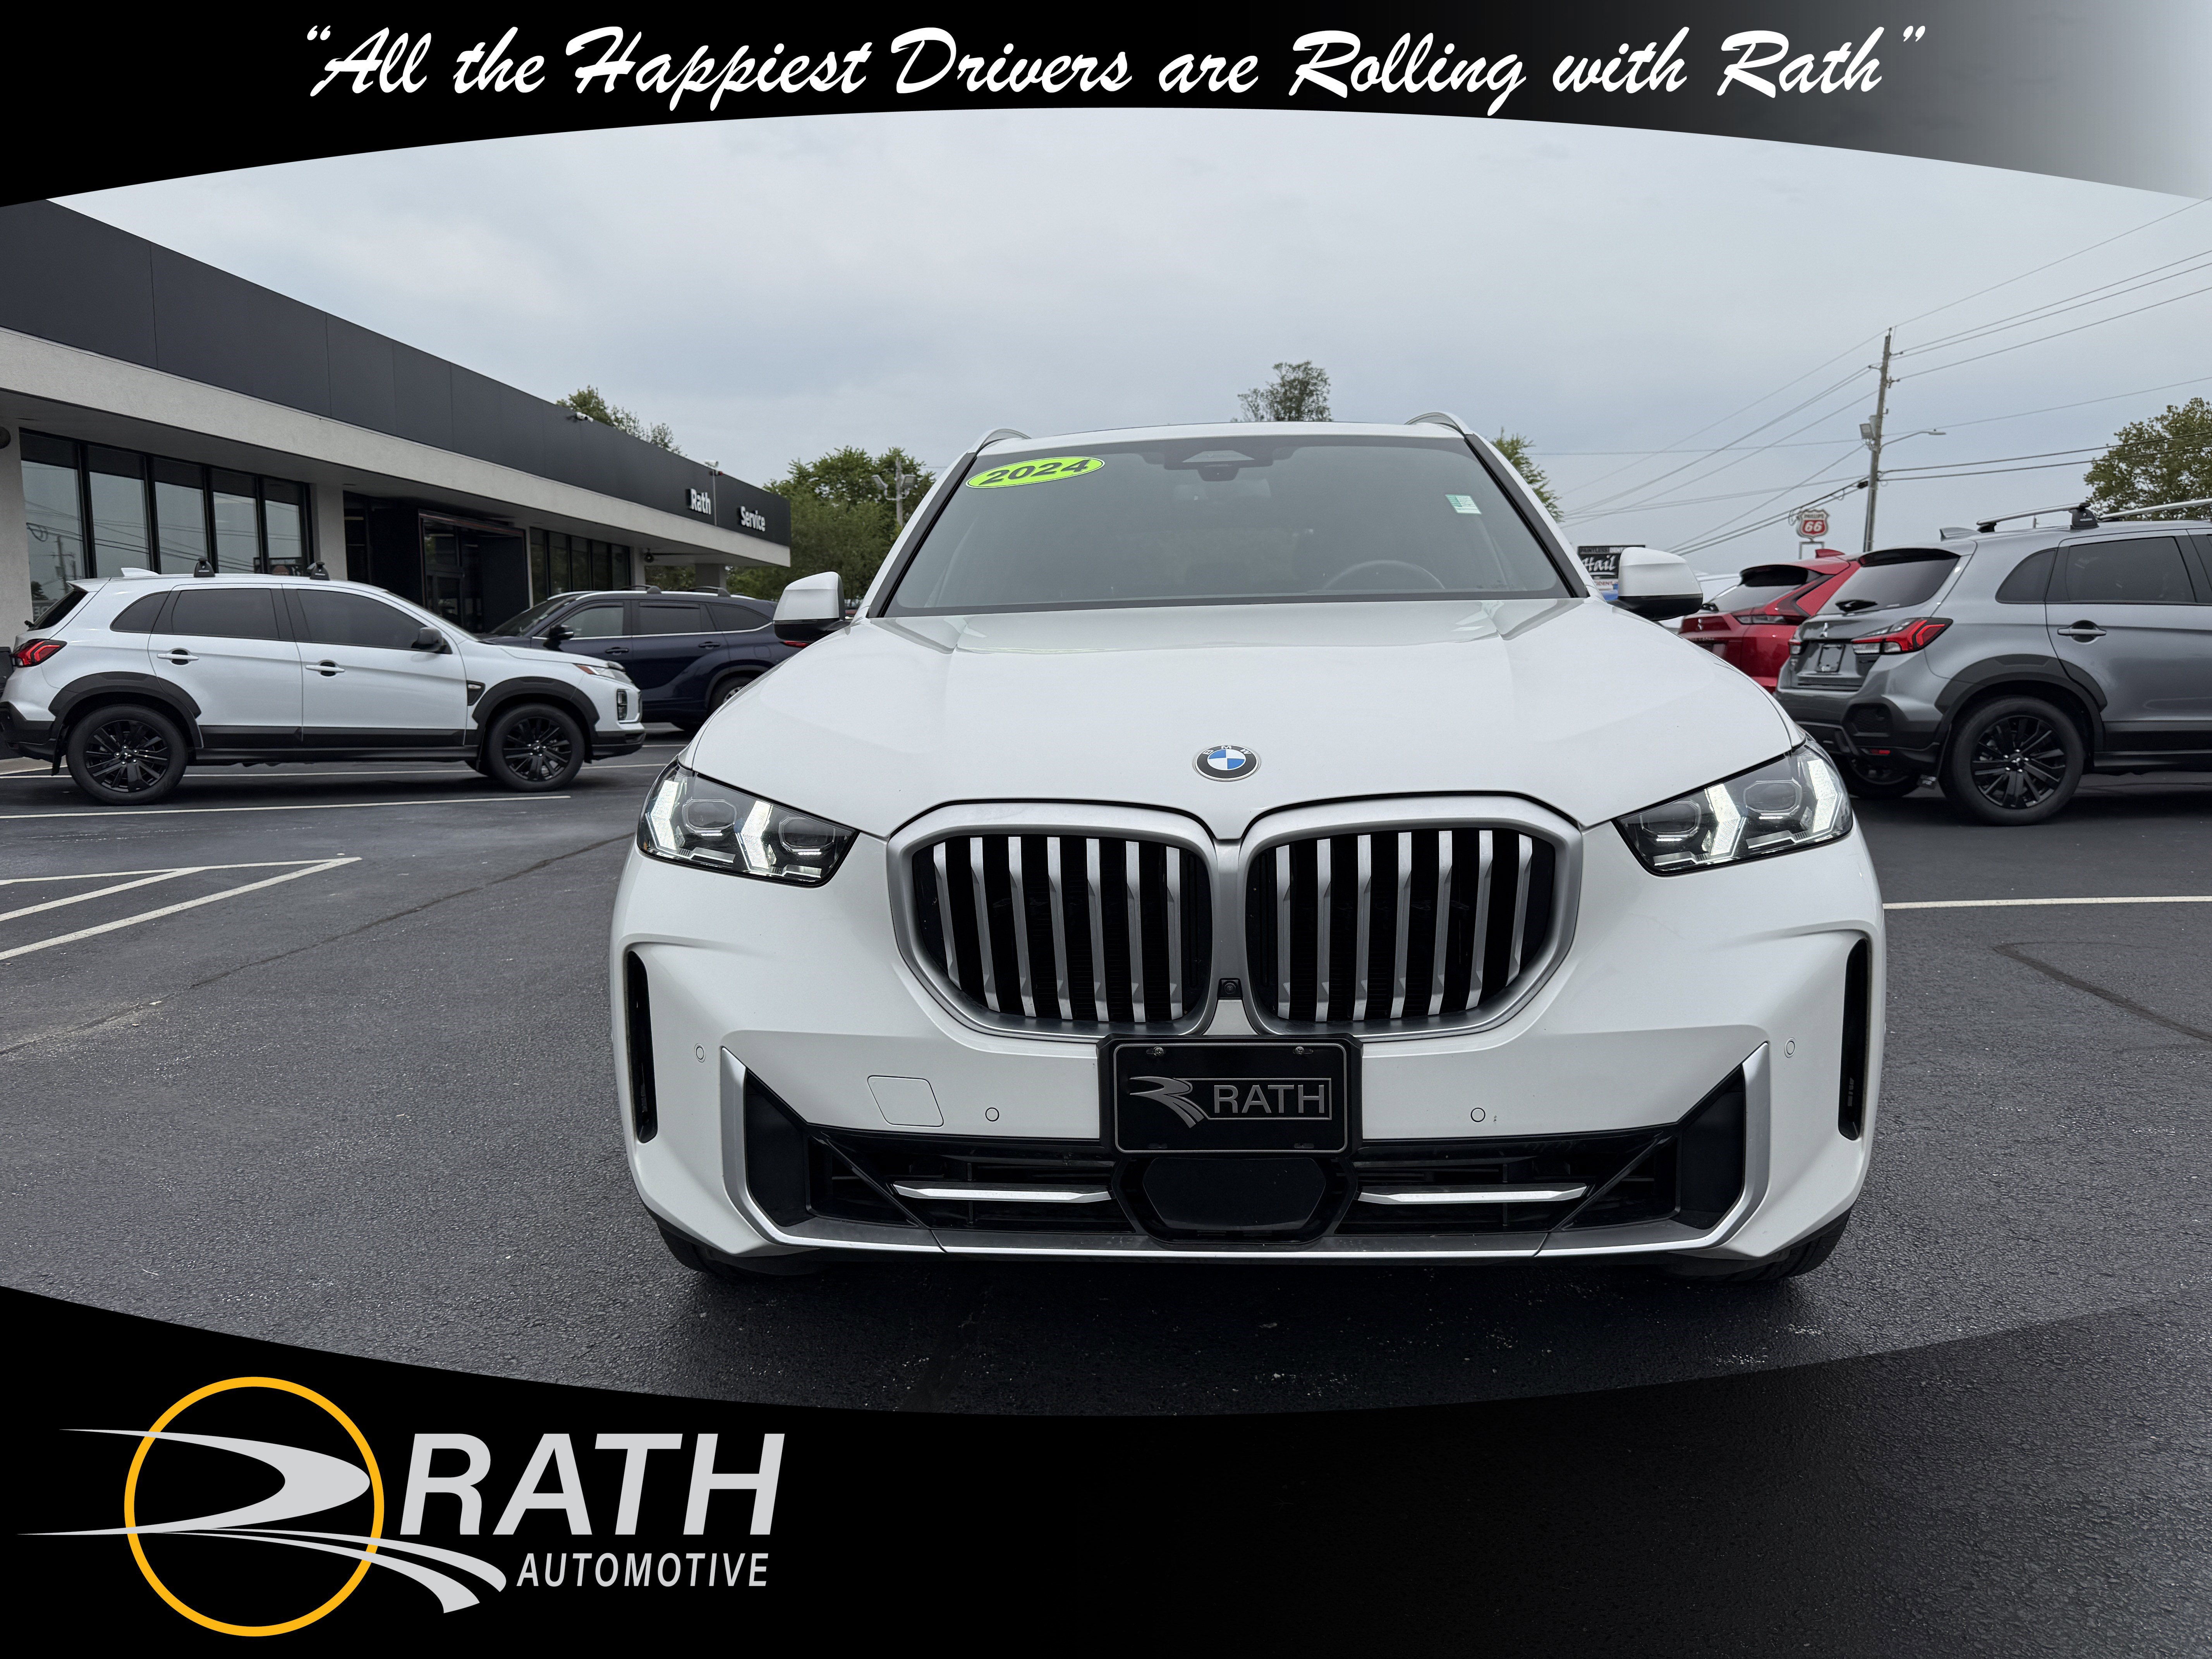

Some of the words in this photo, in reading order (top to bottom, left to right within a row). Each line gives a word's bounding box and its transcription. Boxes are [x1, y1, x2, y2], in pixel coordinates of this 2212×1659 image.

[978, 459, 1091, 486] 2024
[690, 488, 711, 515] Rath
[740, 506, 766, 532] Service
[1805, 521, 1822, 532] 66
[1582, 555, 1617, 572] Hail
[1202, 745, 1252, 755] BMW
[1214, 1084, 1324, 1113] RATH
